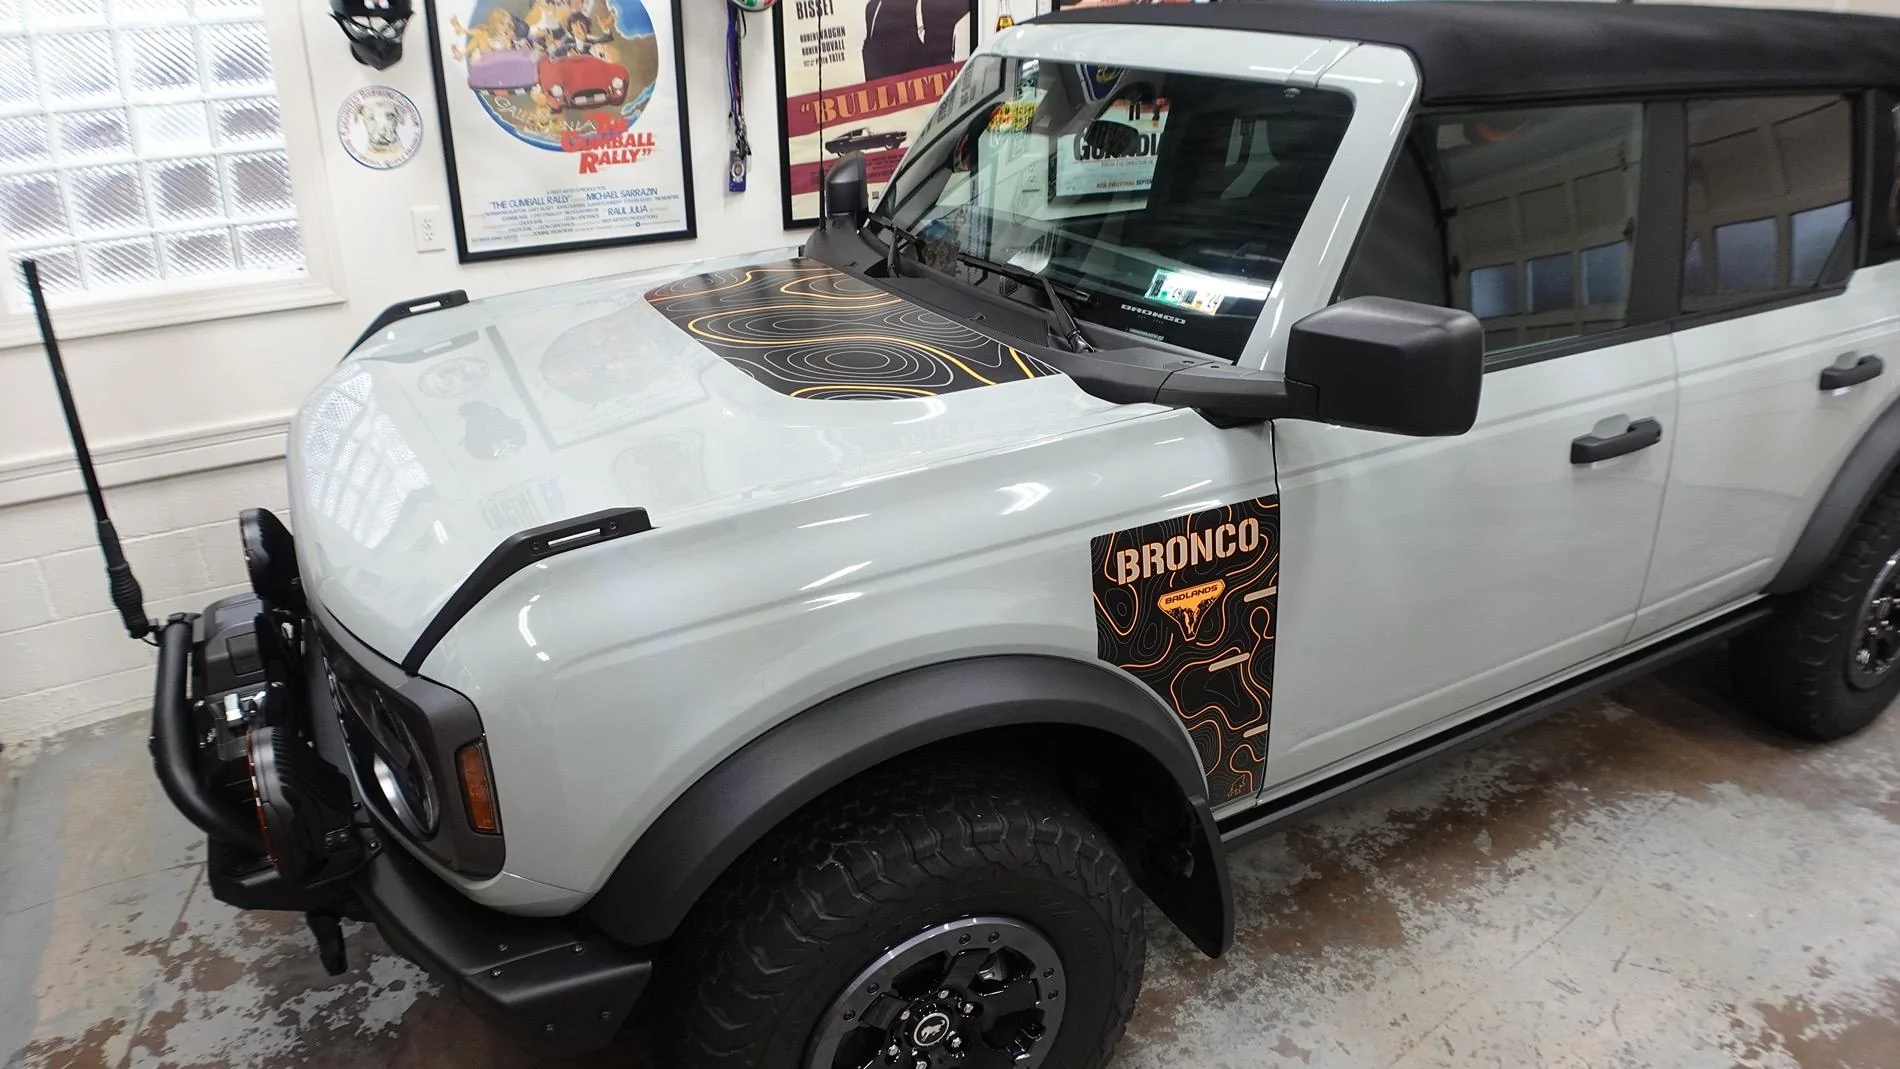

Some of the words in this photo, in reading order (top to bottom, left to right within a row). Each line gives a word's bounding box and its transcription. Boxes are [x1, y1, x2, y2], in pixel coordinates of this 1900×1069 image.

[561, 131, 656, 153] GUMBALL
[509, 197, 546, 208] GUMBALL
[586, 191, 619, 201] MICHAEL
[607, 207, 627, 216] RAUL
[629, 204, 648, 214] JULIA
[1120, 303, 1187, 325] BRONCO
[1116, 517, 1260, 586] BRONCO
[1165, 584, 1218, 605] BADLANDS
